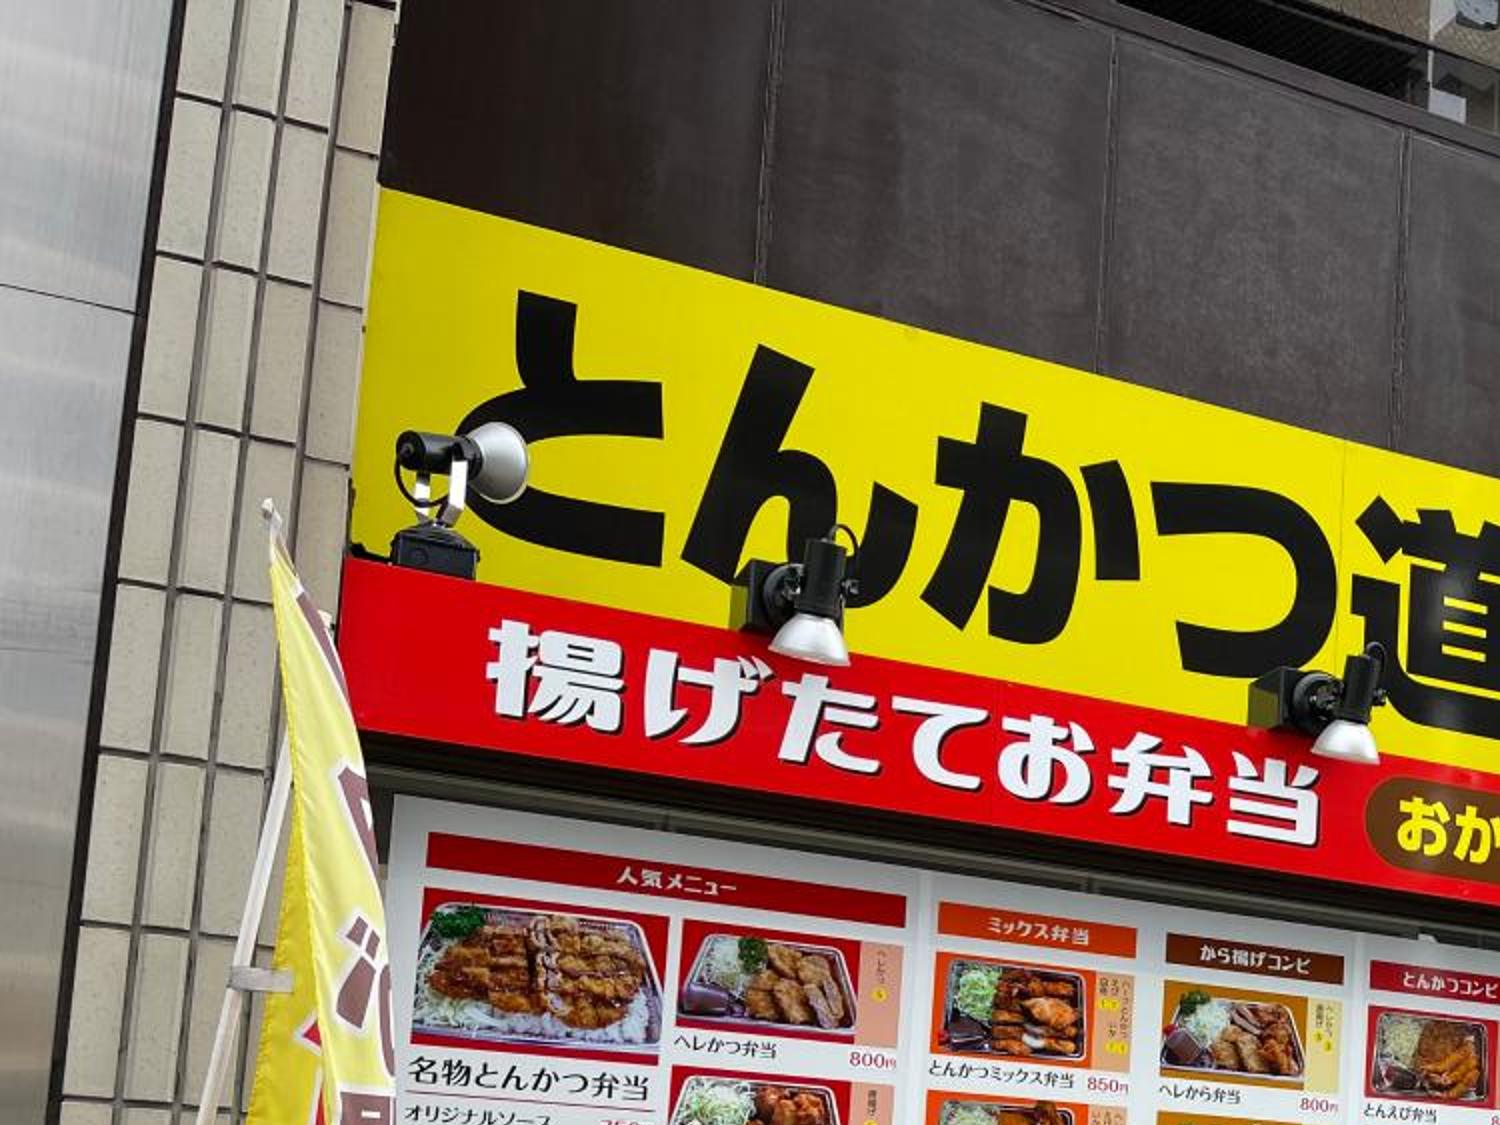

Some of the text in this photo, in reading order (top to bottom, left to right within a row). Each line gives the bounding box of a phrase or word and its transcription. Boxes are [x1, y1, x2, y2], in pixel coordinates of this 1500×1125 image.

[486, 618, 1322, 850] 揚げたてお弁当
[615, 868, 738, 897] 人気メニュー
[987, 916, 1089, 946] ミックス弁当
[1199, 944, 1311, 975] から揚げコンビ
[1402, 971, 1499, 999] とんかつコンビ
[849, 1051, 897, 1069] 800円
[406, 1056, 651, 1101] 名物とんかつ弁当
[928, 1059, 1128, 1094] とんかつミックス弁当 850円
[1300, 1096, 1339, 1114] 800円
